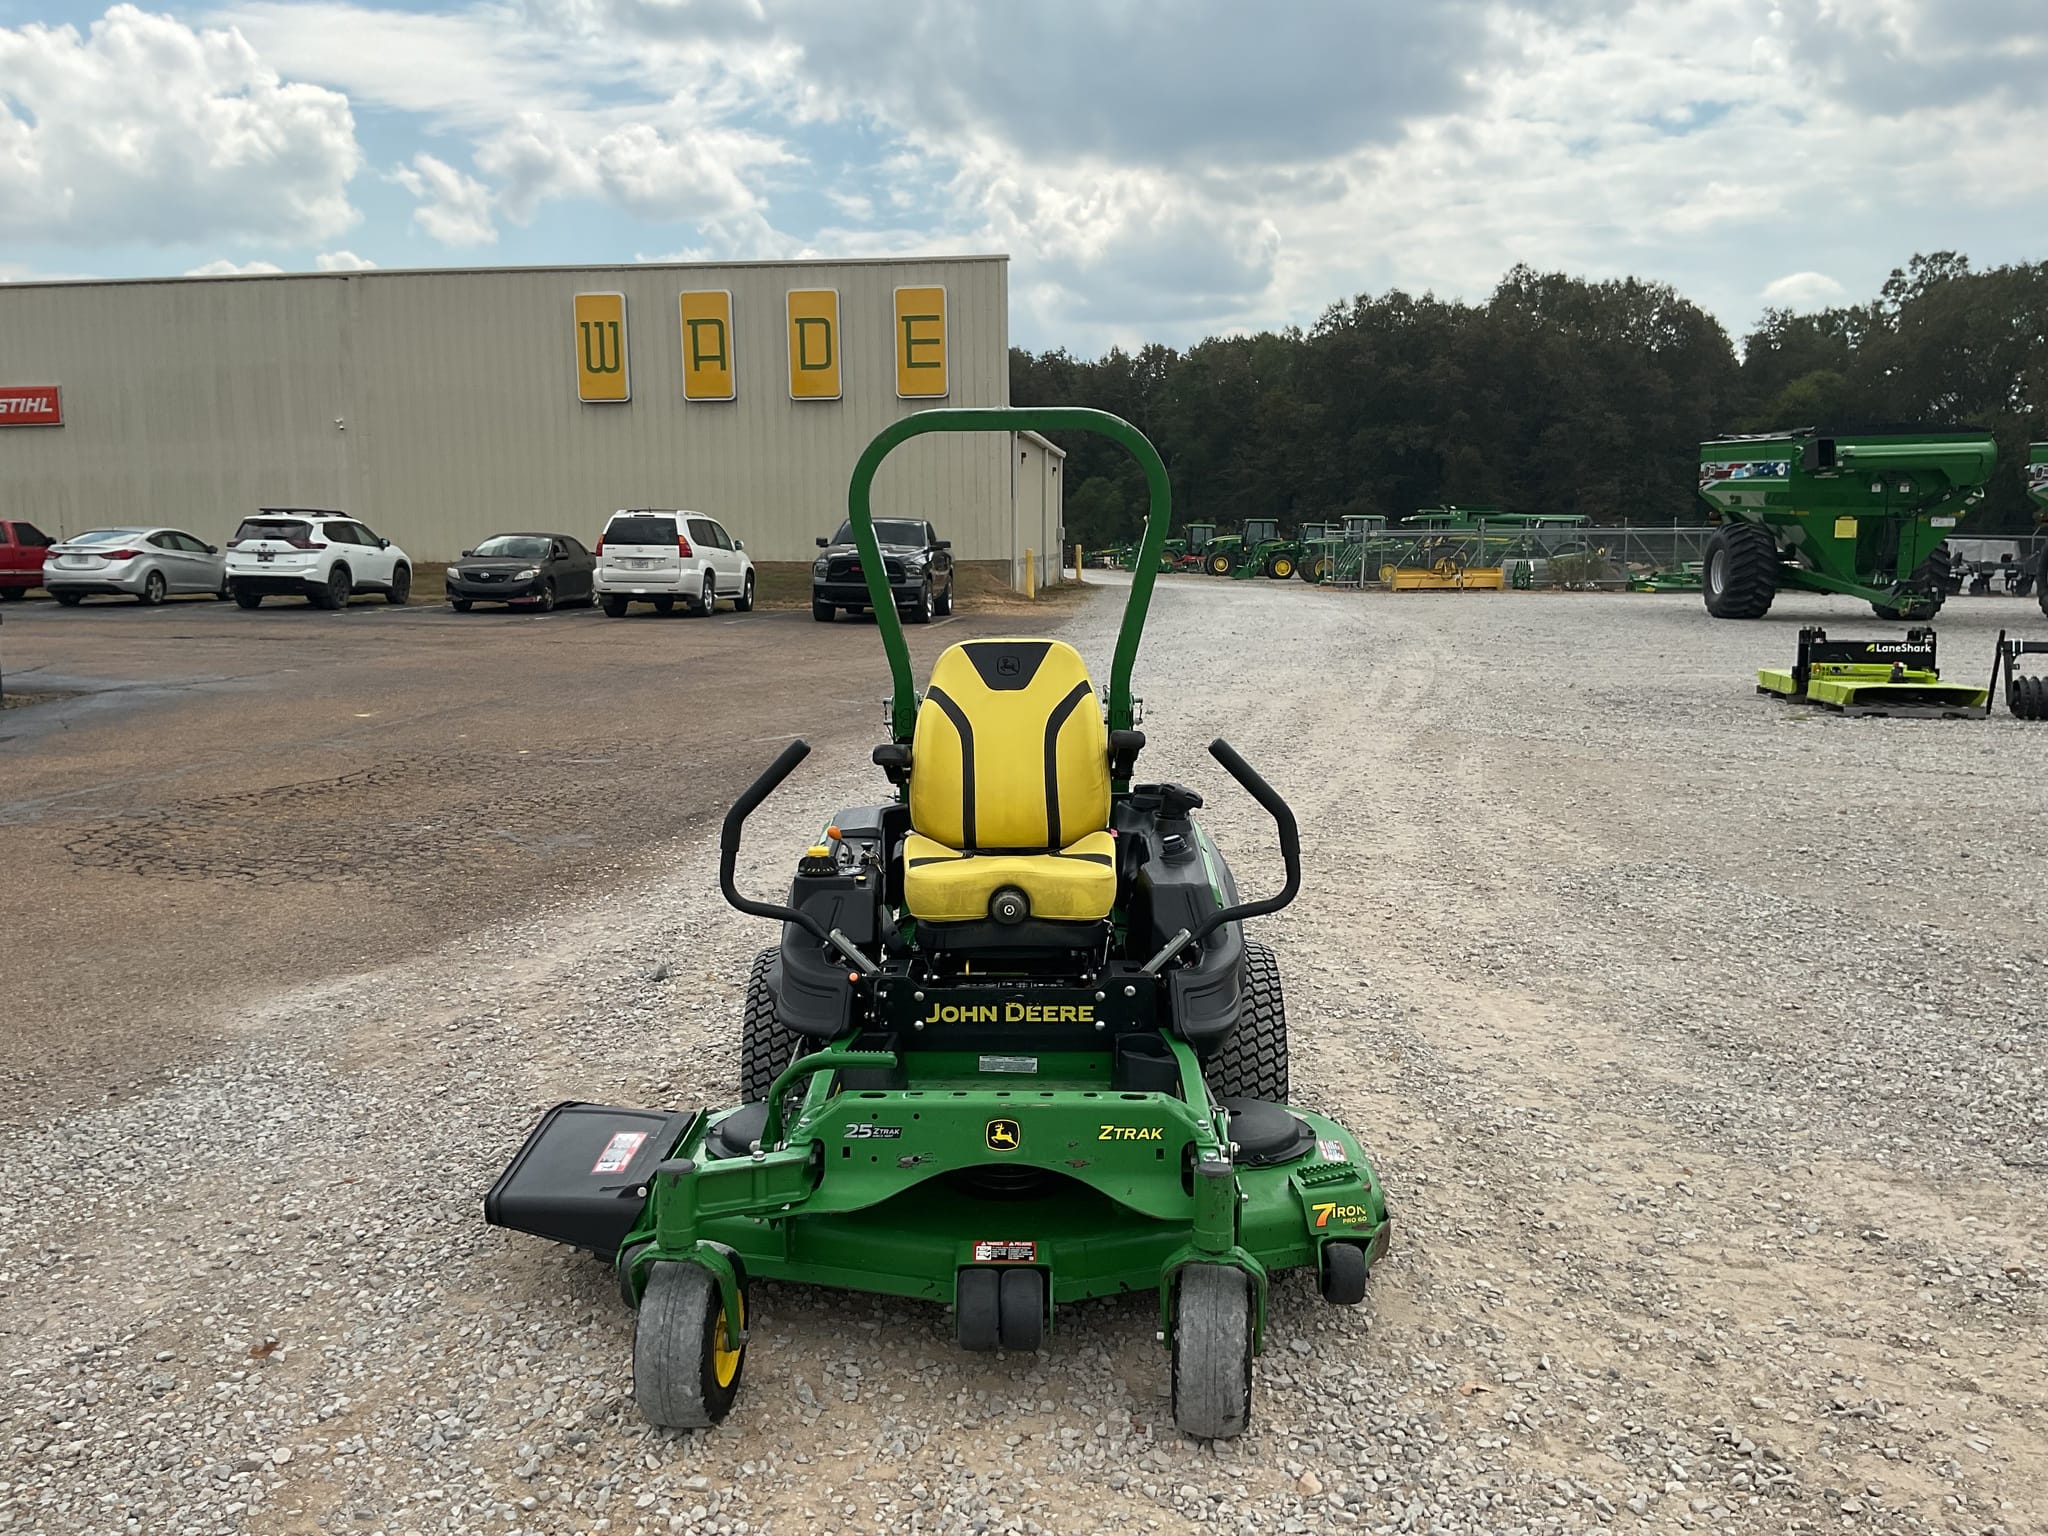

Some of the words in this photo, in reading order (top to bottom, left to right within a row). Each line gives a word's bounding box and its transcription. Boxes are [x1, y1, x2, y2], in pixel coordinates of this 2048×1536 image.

[580, 315, 941, 373] WADE
[1876, 643, 1931, 653] LaneShark
[926, 1003, 998, 1022] JOHN
[1005, 1003, 1094, 1022] DEERE
[844, 1123, 873, 1138] 25
[873, 1127, 900, 1135] ZTRAK
[1098, 1125, 1163, 1140] ZTRAK
